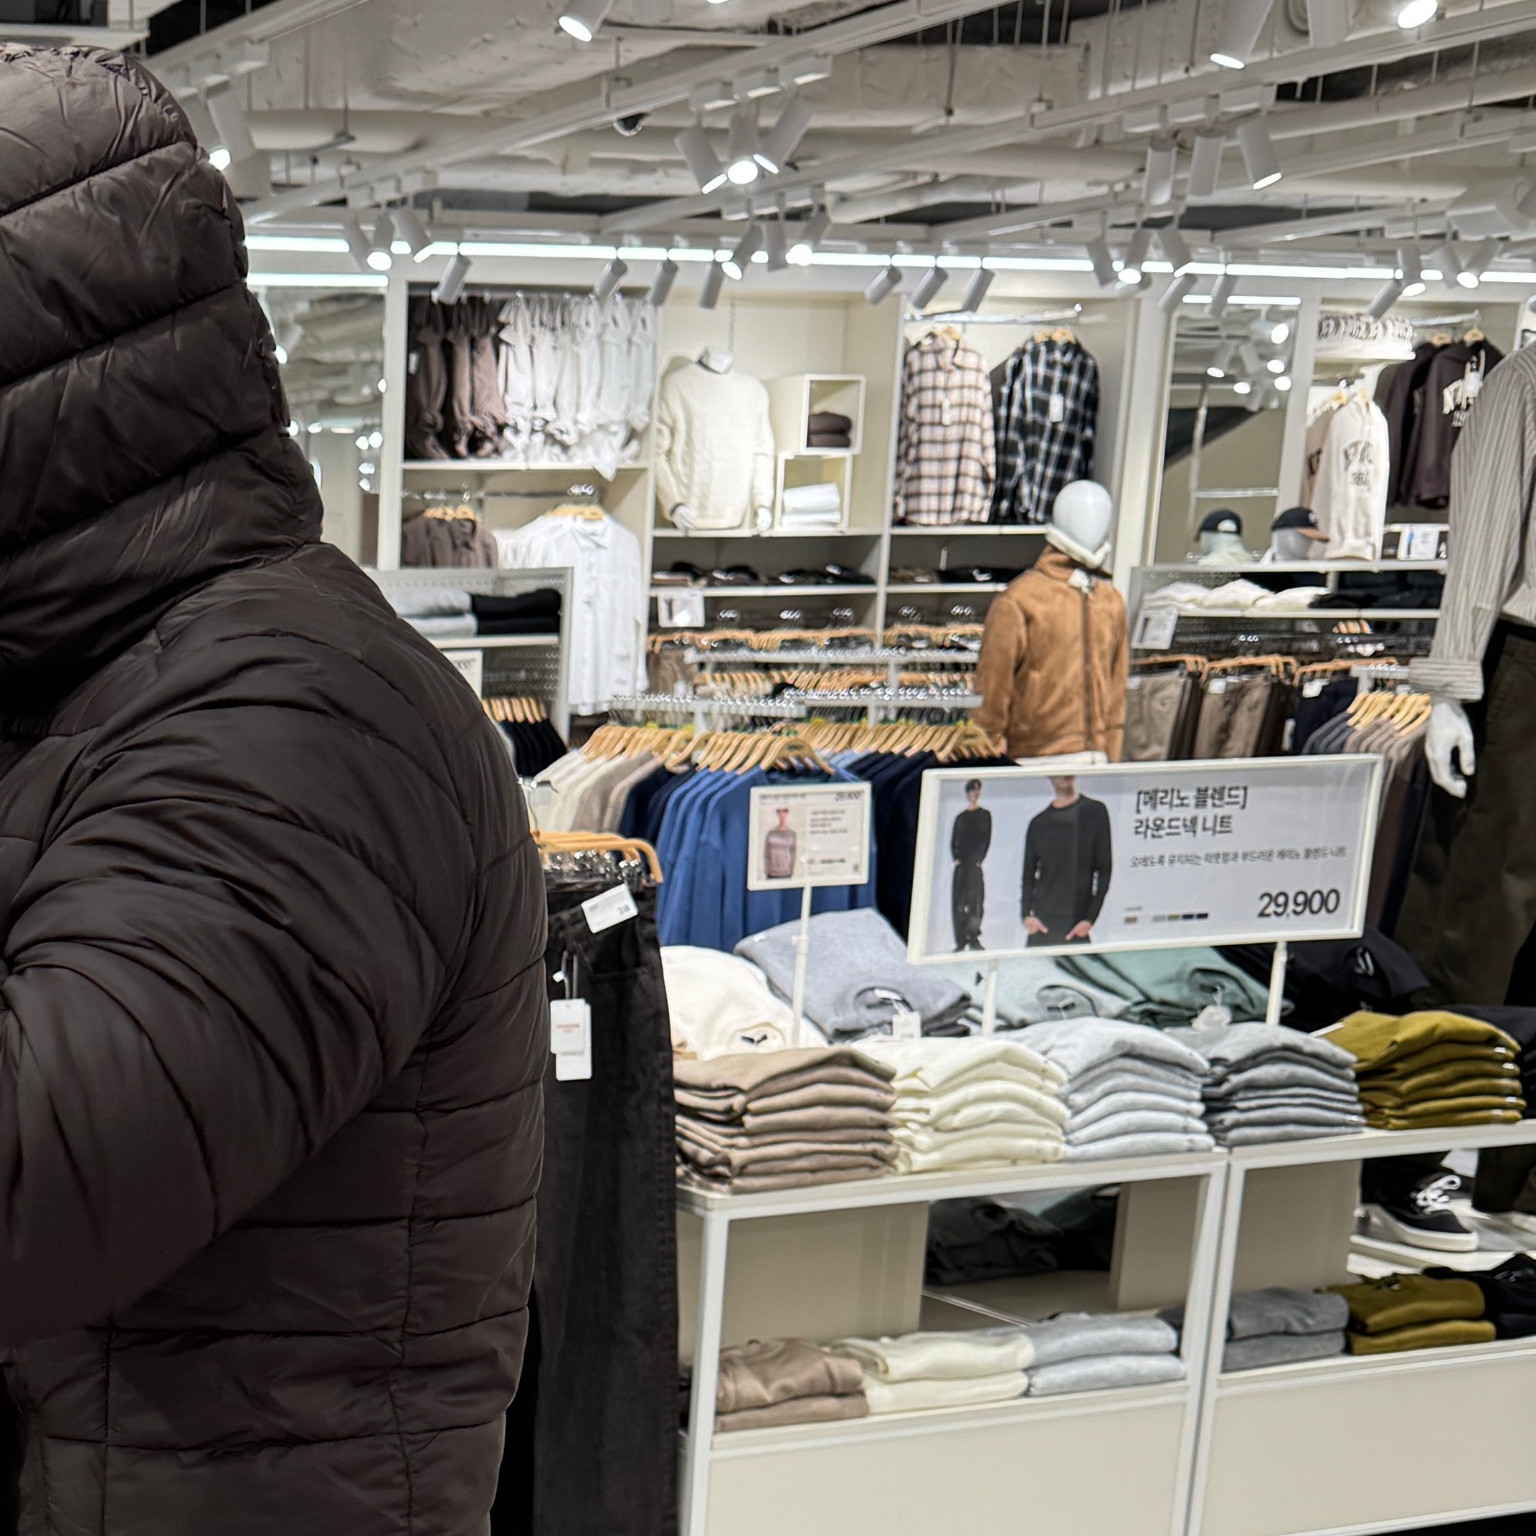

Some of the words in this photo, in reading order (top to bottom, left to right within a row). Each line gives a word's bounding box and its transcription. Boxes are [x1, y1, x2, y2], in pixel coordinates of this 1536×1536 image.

[1135, 786, 1190, 814] [메리노
[1193, 784, 1248, 810] 블렌드]
[1134, 815, 1198, 840] 라운드넥
[1202, 814, 1234, 838] 니트
[1258, 888, 1340, 919] 29,900
